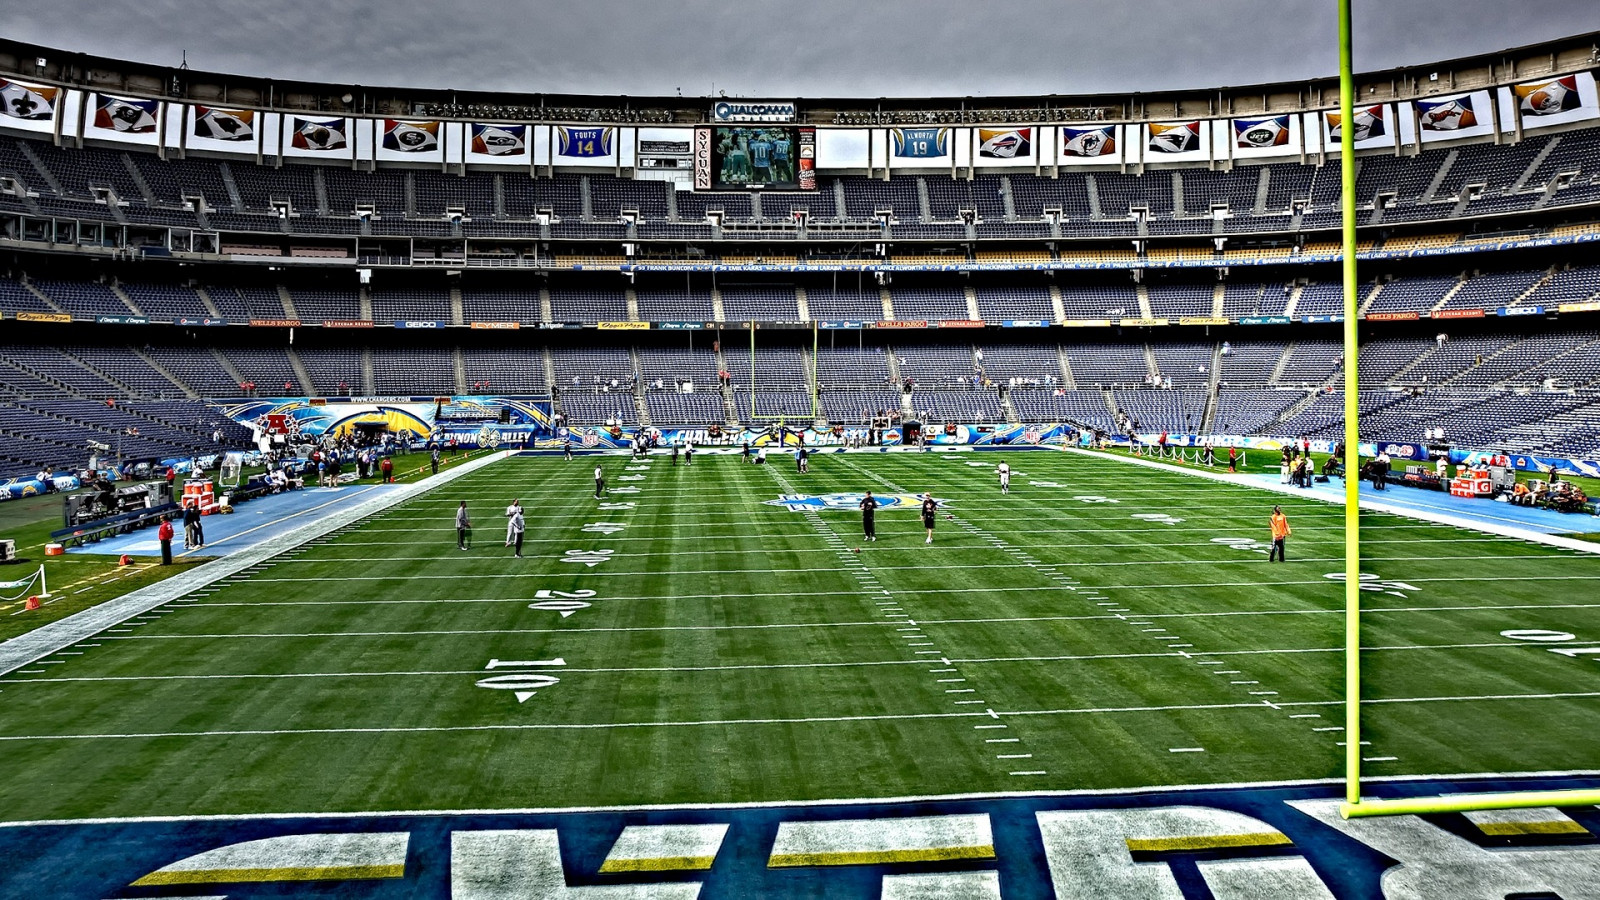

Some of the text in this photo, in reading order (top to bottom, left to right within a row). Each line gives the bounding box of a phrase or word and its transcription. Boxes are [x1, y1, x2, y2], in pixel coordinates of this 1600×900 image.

[907, 132, 934, 140] ALWORTH
[577, 141, 594, 155] 14
[912, 141, 927, 155] 19
[698, 131, 709, 187] SYCUAN
[1393, 311, 1417, 319] FARGO
[501, 432, 532, 443] ALLEY
[528, 589, 597, 610] 20
[475, 658, 567, 689] 10
